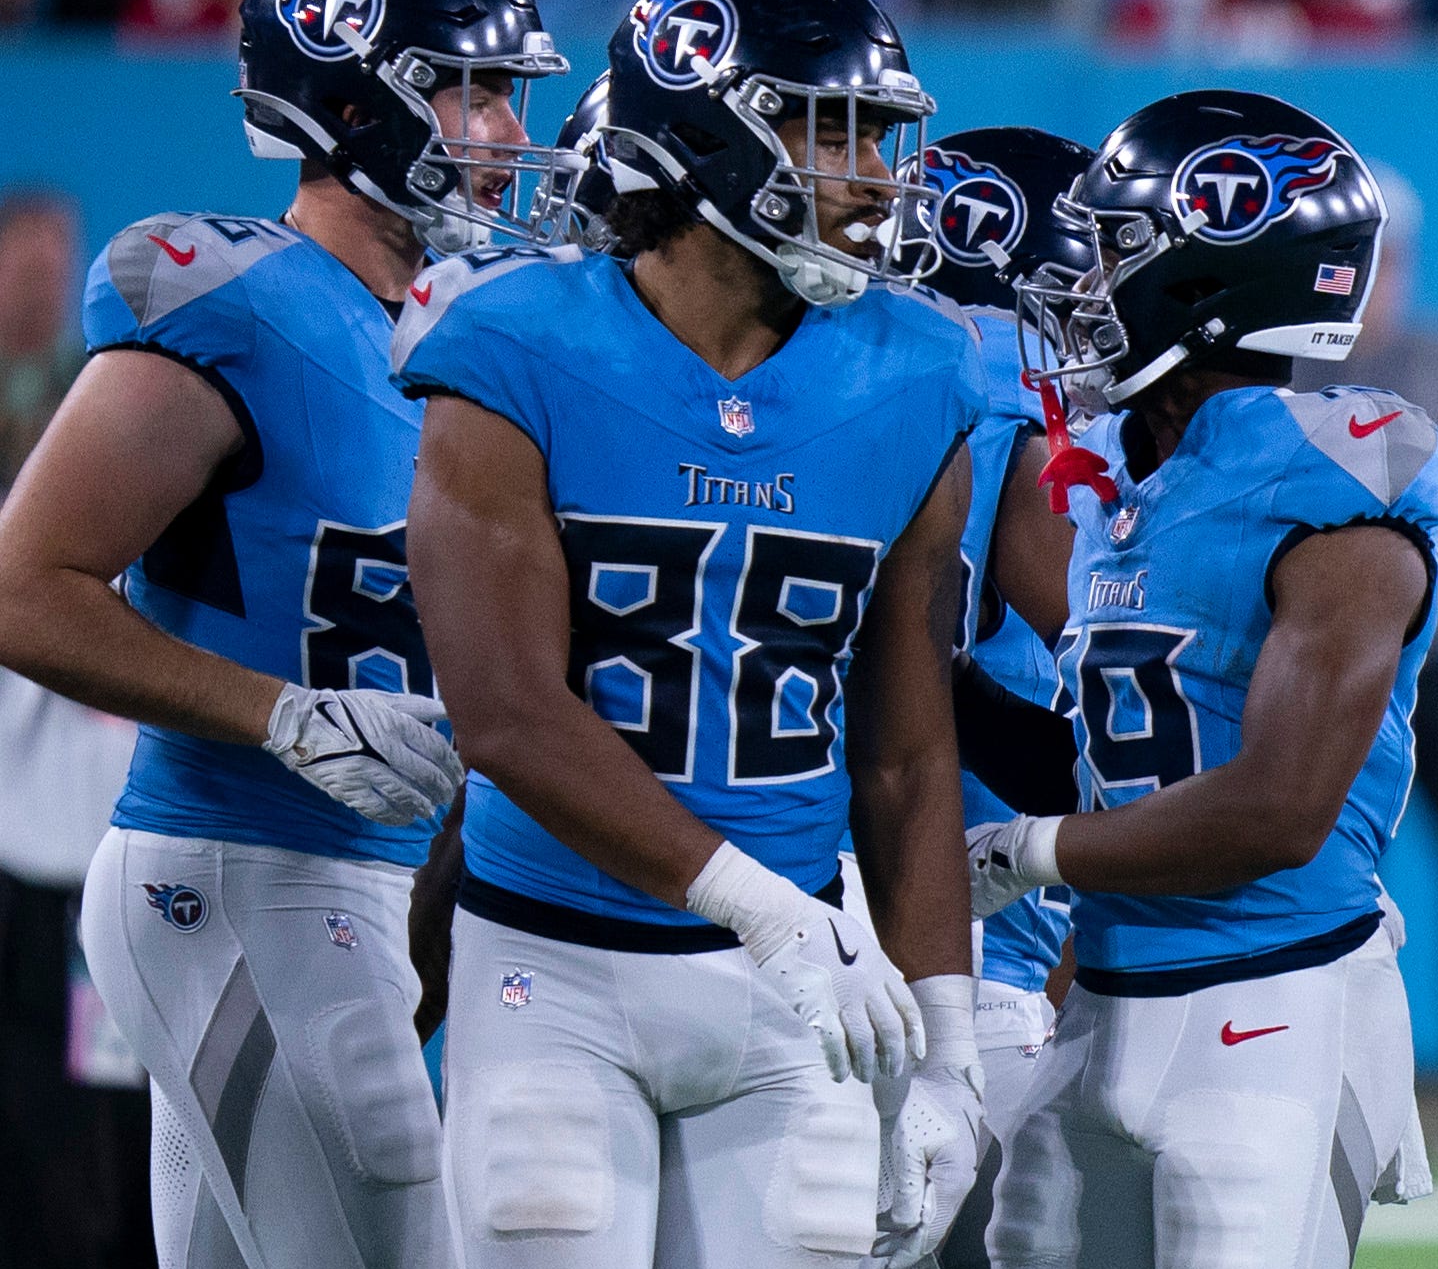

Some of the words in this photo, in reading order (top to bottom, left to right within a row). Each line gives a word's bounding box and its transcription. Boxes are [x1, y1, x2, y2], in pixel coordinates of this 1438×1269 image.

[1310, 332, 1325, 345] IT
[678, 462, 795, 515] TITANS
[1087, 569, 1149, 611] TITANS
[554, 512, 885, 787] 88
[976, 1000, 1018, 1011] RI-FIT
